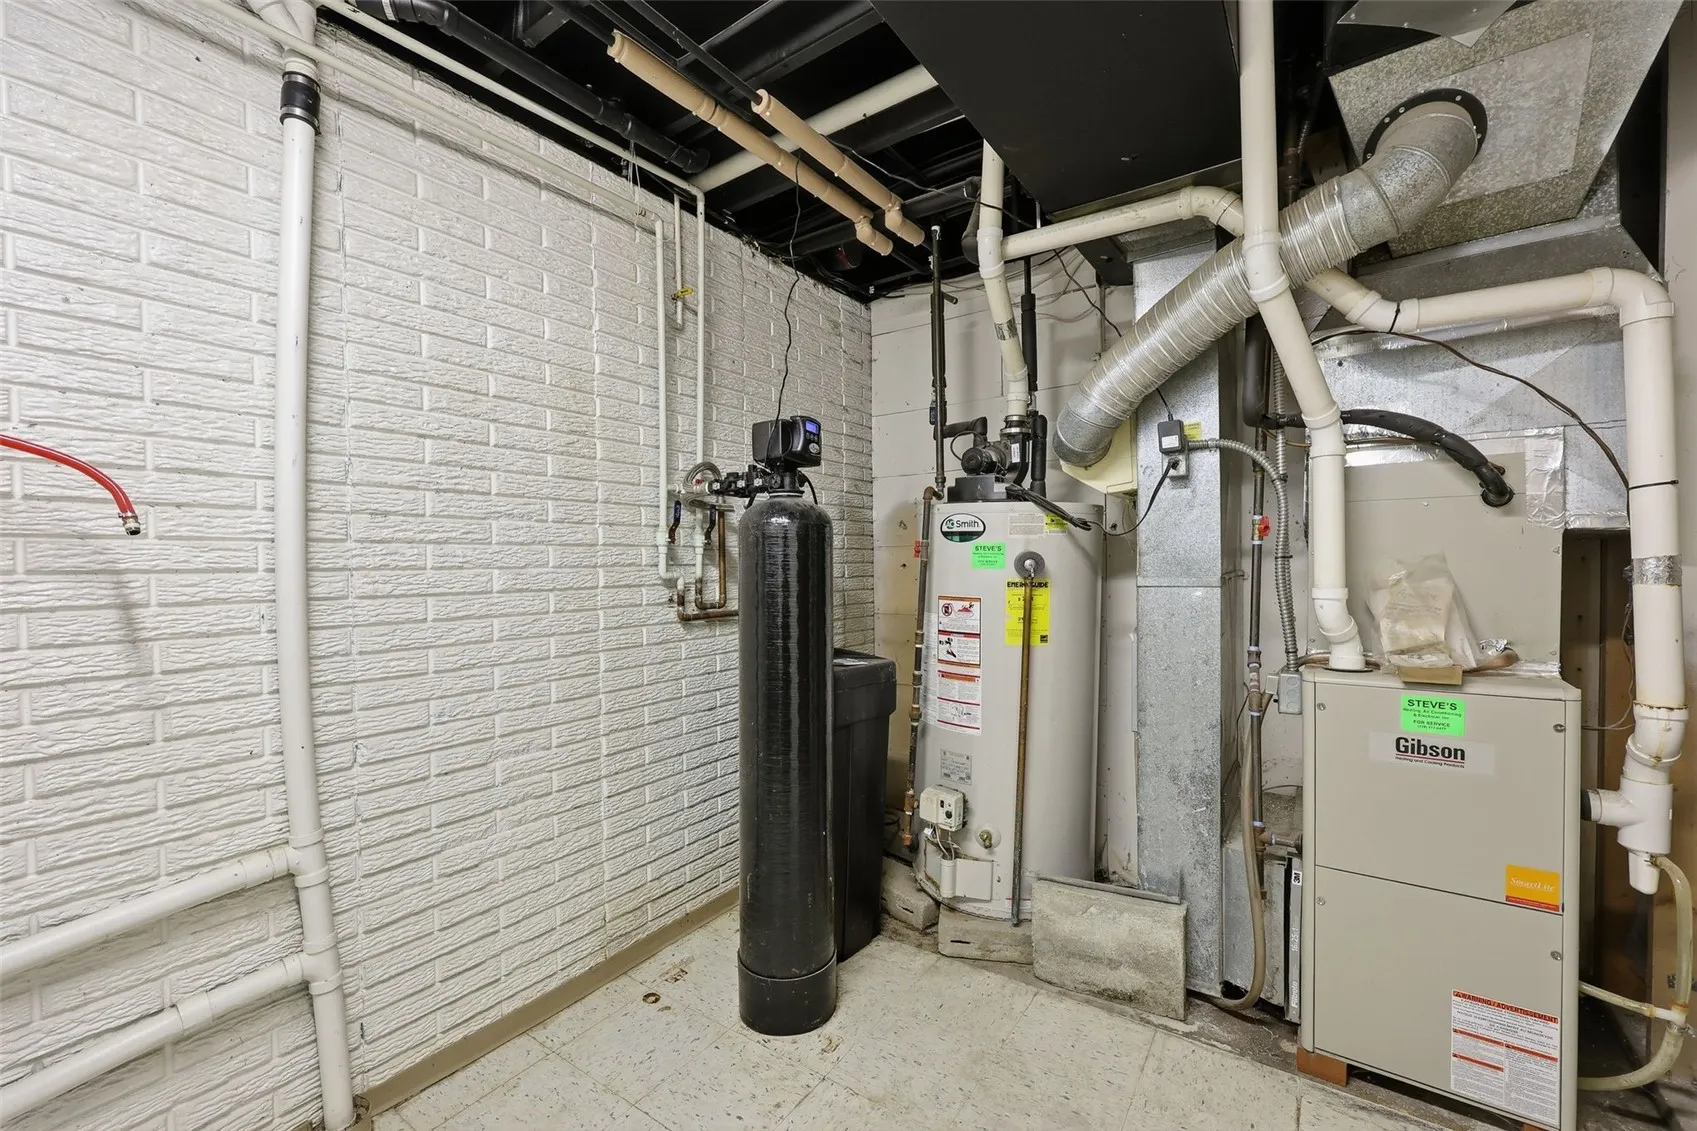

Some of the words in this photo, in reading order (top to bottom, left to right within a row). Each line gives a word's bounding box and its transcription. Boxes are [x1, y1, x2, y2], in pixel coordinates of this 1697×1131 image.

[955, 519, 980, 528] Smith
[1407, 699, 1457, 710] STEVE'S
[1395, 736, 1466, 761] Gibson
[1293, 872, 1301, 884] 3M
[1461, 991, 1492, 1006] WARNING
